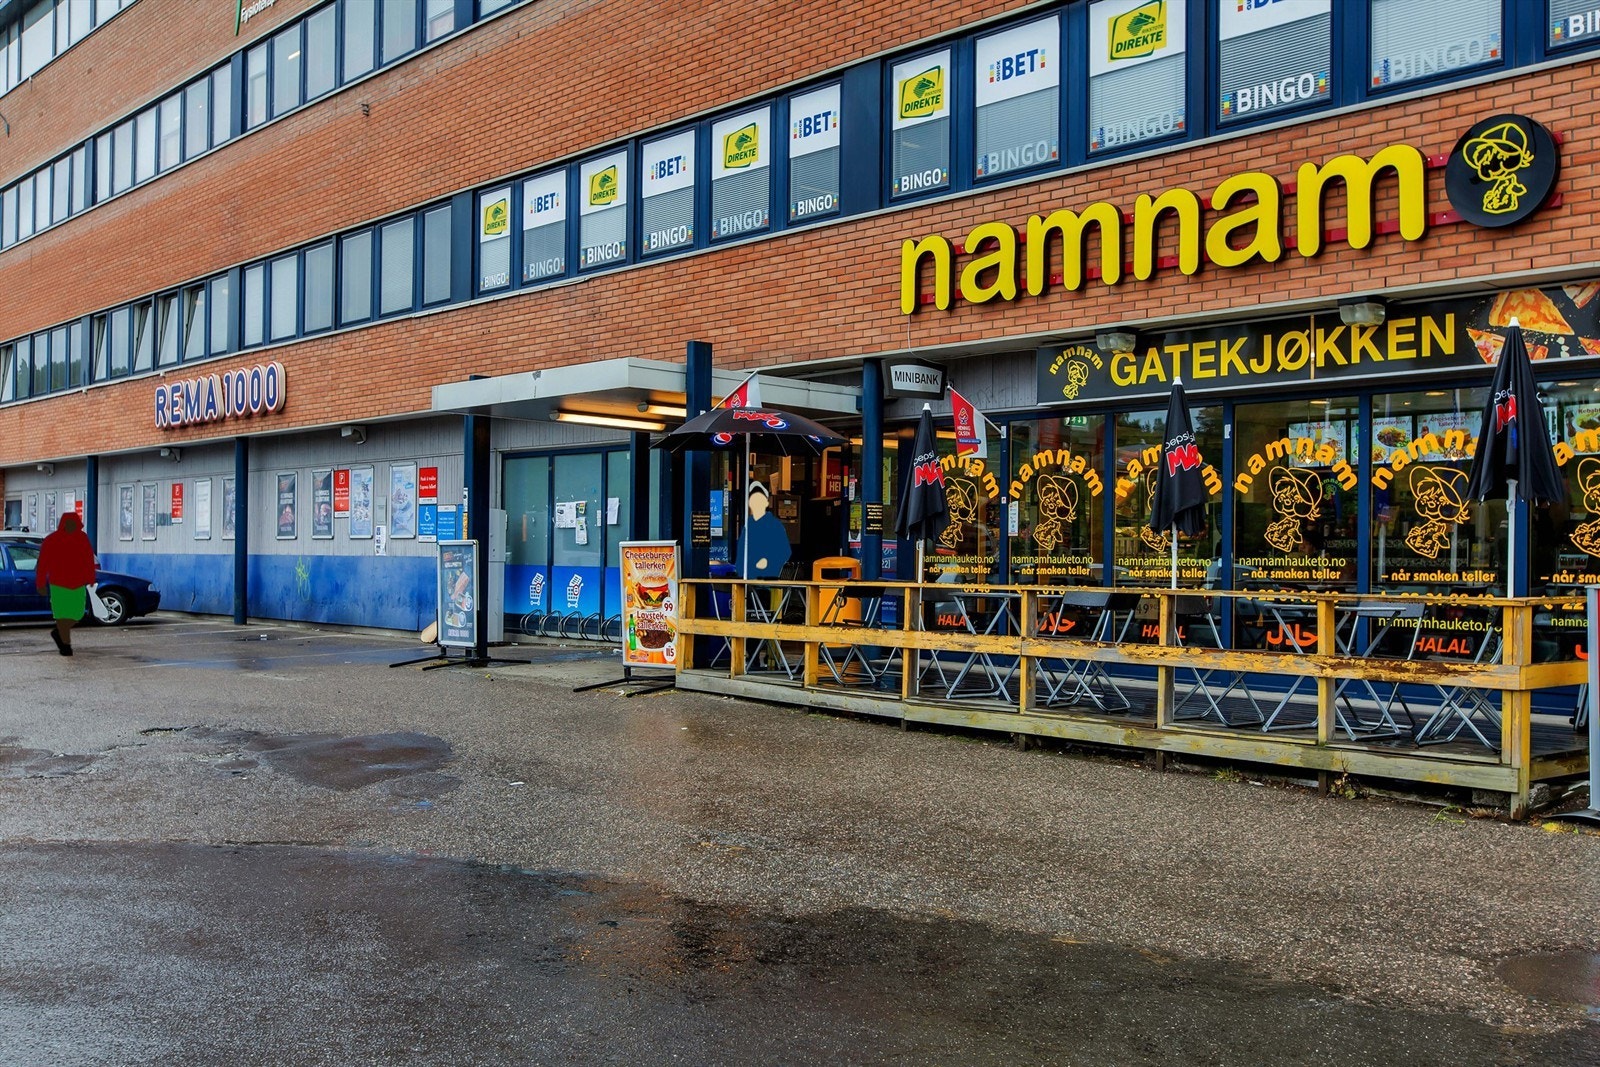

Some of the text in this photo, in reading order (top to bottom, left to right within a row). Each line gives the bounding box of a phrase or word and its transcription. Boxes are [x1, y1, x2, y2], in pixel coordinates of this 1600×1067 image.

[1115, 30, 1163, 53] DIREKTE
[1002, 48, 1039, 81] BET
[1390, 36, 1484, 81] BINGO
[904, 94, 941, 113] DIREKTE
[1236, 72, 1315, 113] BINGO
[803, 110, 832, 138] BET
[1105, 112, 1174, 147] BINGO
[727, 147, 757, 164] DIREKTE
[988, 140, 1048, 174] BINGO
[659, 155, 682, 179] BET
[901, 168, 942, 192] BINGO
[536, 192, 556, 213] BET
[592, 187, 617, 201] DIREKTE
[797, 194, 833, 216] BINGO
[486, 218, 507, 231] DIREKTE
[720, 209, 764, 236] BINGO
[900, 143, 1426, 316] namnam
[650, 225, 688, 250] BINGO
[587, 241, 620, 264] BINGO
[529, 257, 560, 279] BINGO
[484, 273, 506, 288] BINGO
[1049, 345, 1104, 375] namnam
[1110, 312, 1457, 388] GATEKJØKKEN
[894, 370, 940, 386] MINIBANK
[155, 362, 280, 429] REMA 1000
[1008, 448, 1104, 499] namnam
[1234, 436, 1358, 494] namnam
[625, 550, 675, 561] Cheeseburger-
[635, 561, 666, 570] tallerken
[1011, 554, 1094, 565] namnamhauketo.no
[1239, 555, 1346, 567] namnamhauketo.no
[971, 565, 991, 574] teller
[1021, 565, 1035, 575] når
[1036, 567, 1067, 575] smaken
[1068, 566, 1091, 576] teller
[1128, 567, 1144, 577] når
[1182, 567, 1207, 578] teller
[1251, 567, 1268, 578] når
[1270, 569, 1310, 579] smaken
[1312, 568, 1341, 579] teller
[1391, 568, 1410, 581] når
[1413, 570, 1459, 582] smaken
[1462, 570, 1496, 582] teller
[1552, 569, 1575, 583] når
